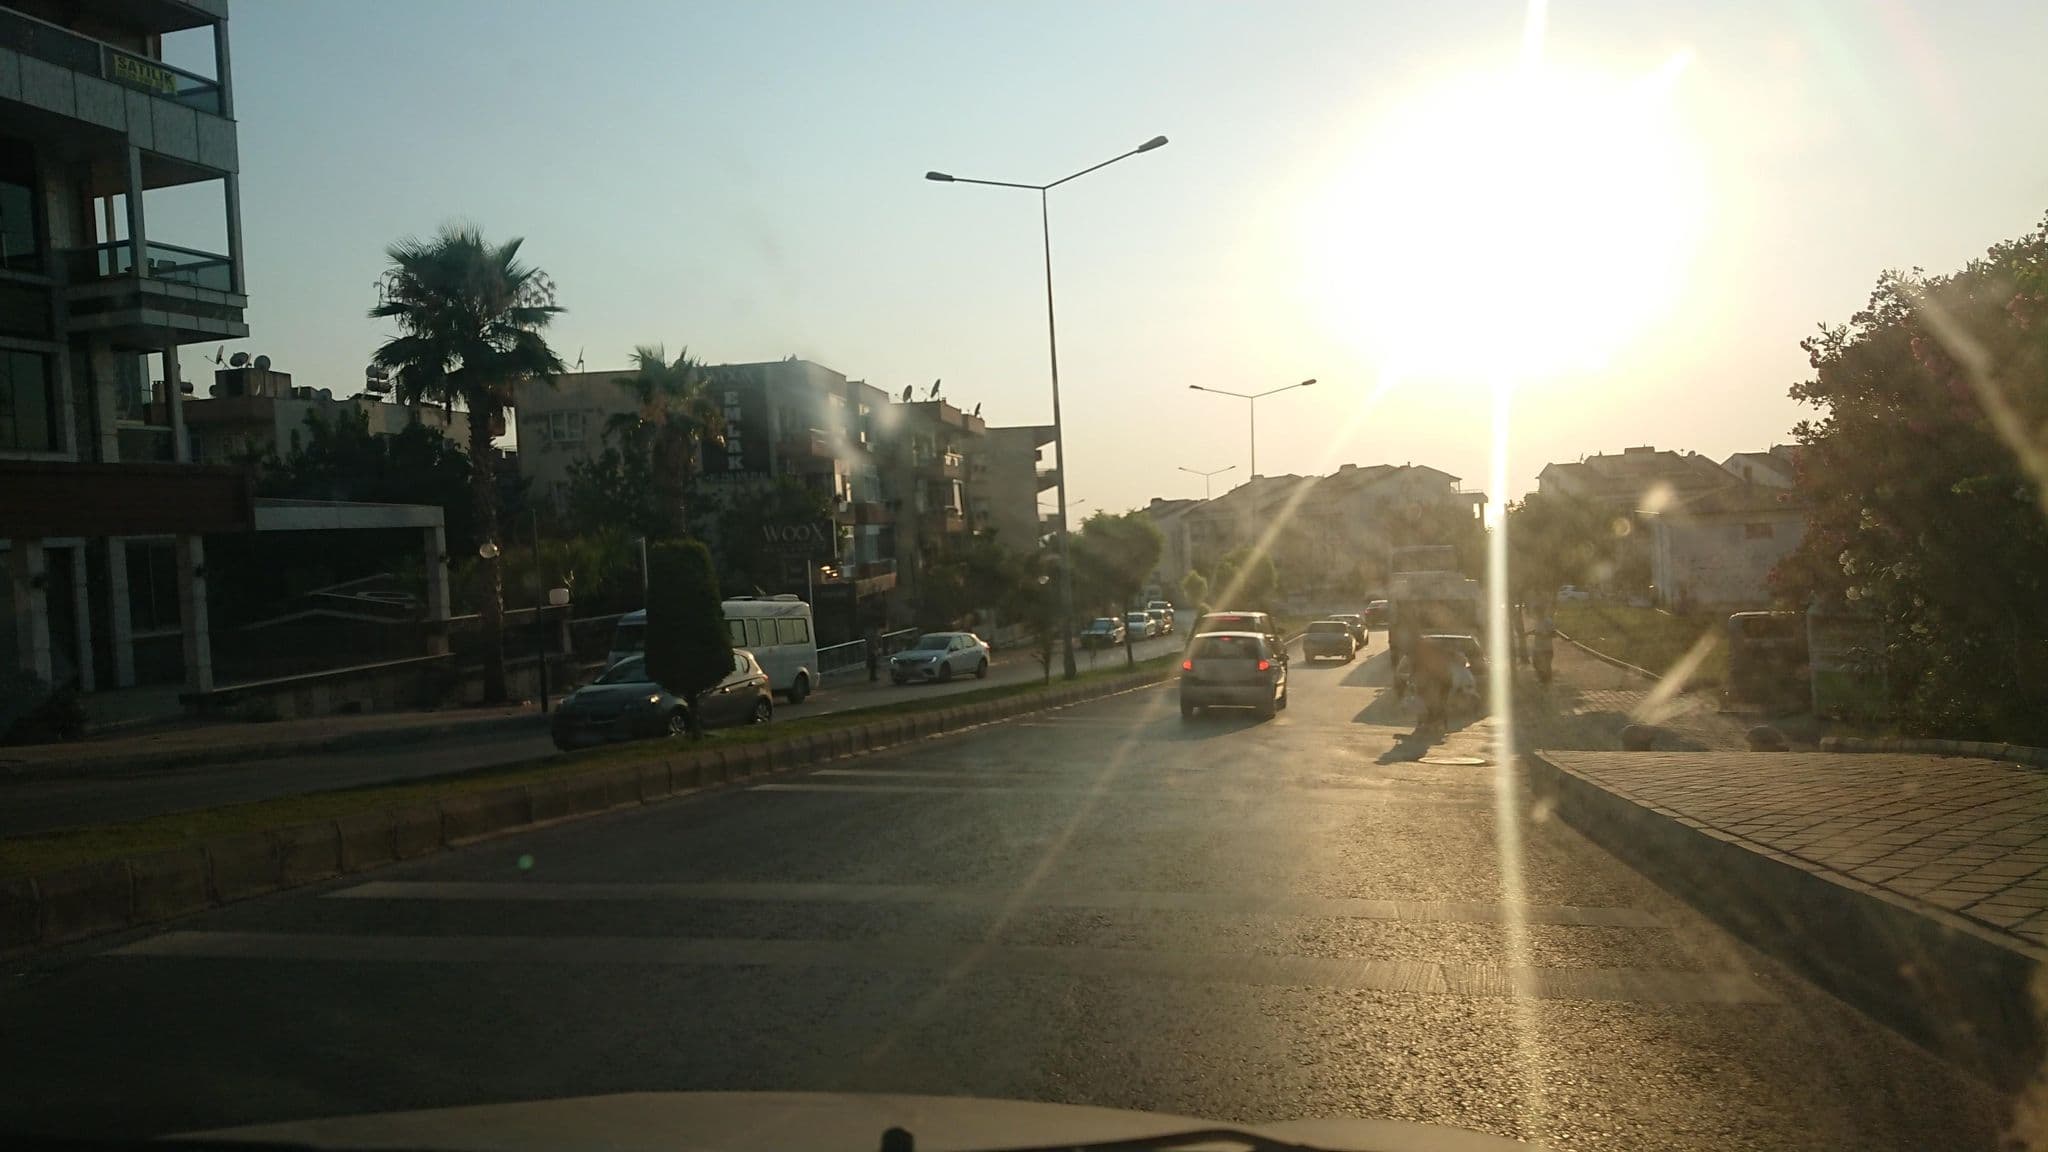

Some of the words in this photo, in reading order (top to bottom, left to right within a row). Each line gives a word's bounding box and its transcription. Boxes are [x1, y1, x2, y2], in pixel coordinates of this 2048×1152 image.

[118, 56, 173, 83] SATILIK
[724, 391, 745, 470] EMLAK
[761, 522, 825, 543] WOOX
